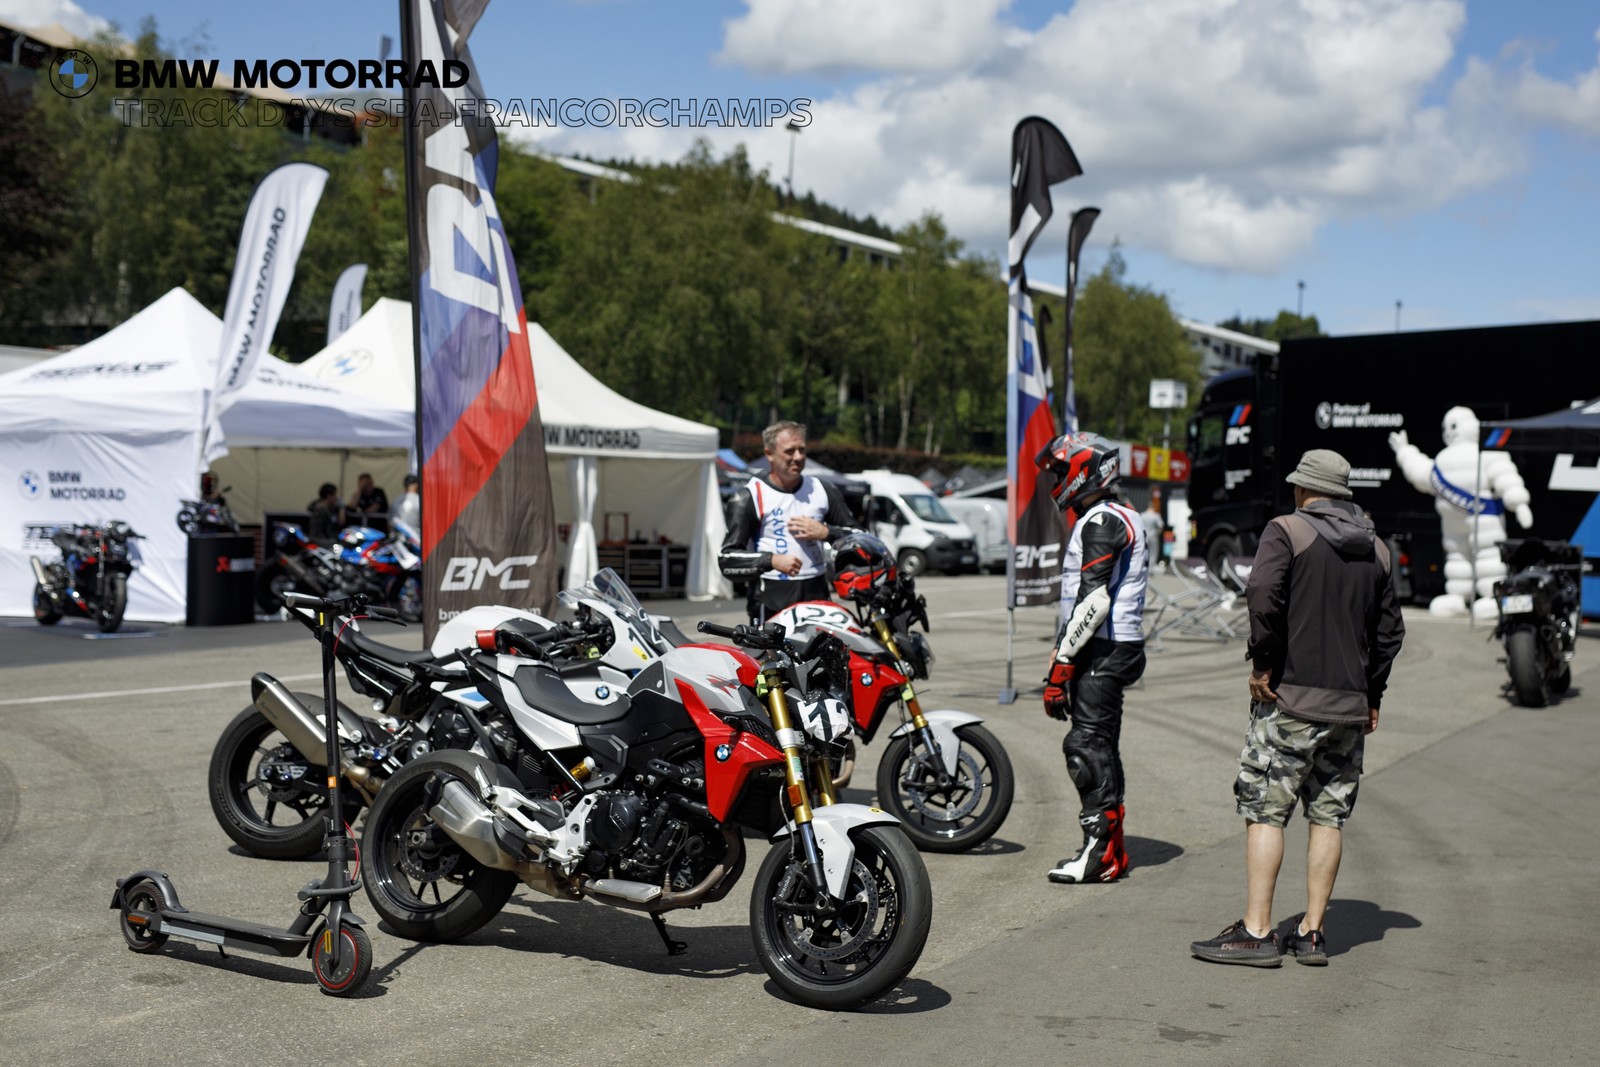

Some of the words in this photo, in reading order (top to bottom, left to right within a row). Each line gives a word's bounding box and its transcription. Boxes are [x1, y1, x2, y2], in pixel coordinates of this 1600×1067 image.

[248, 207, 287, 329] MOTORRAD
[564, 428, 640, 449] MOTORRAD
[48, 471, 81, 483] BMW
[50, 488, 125, 500] MOTORRAD
[440, 555, 539, 592] BMC
